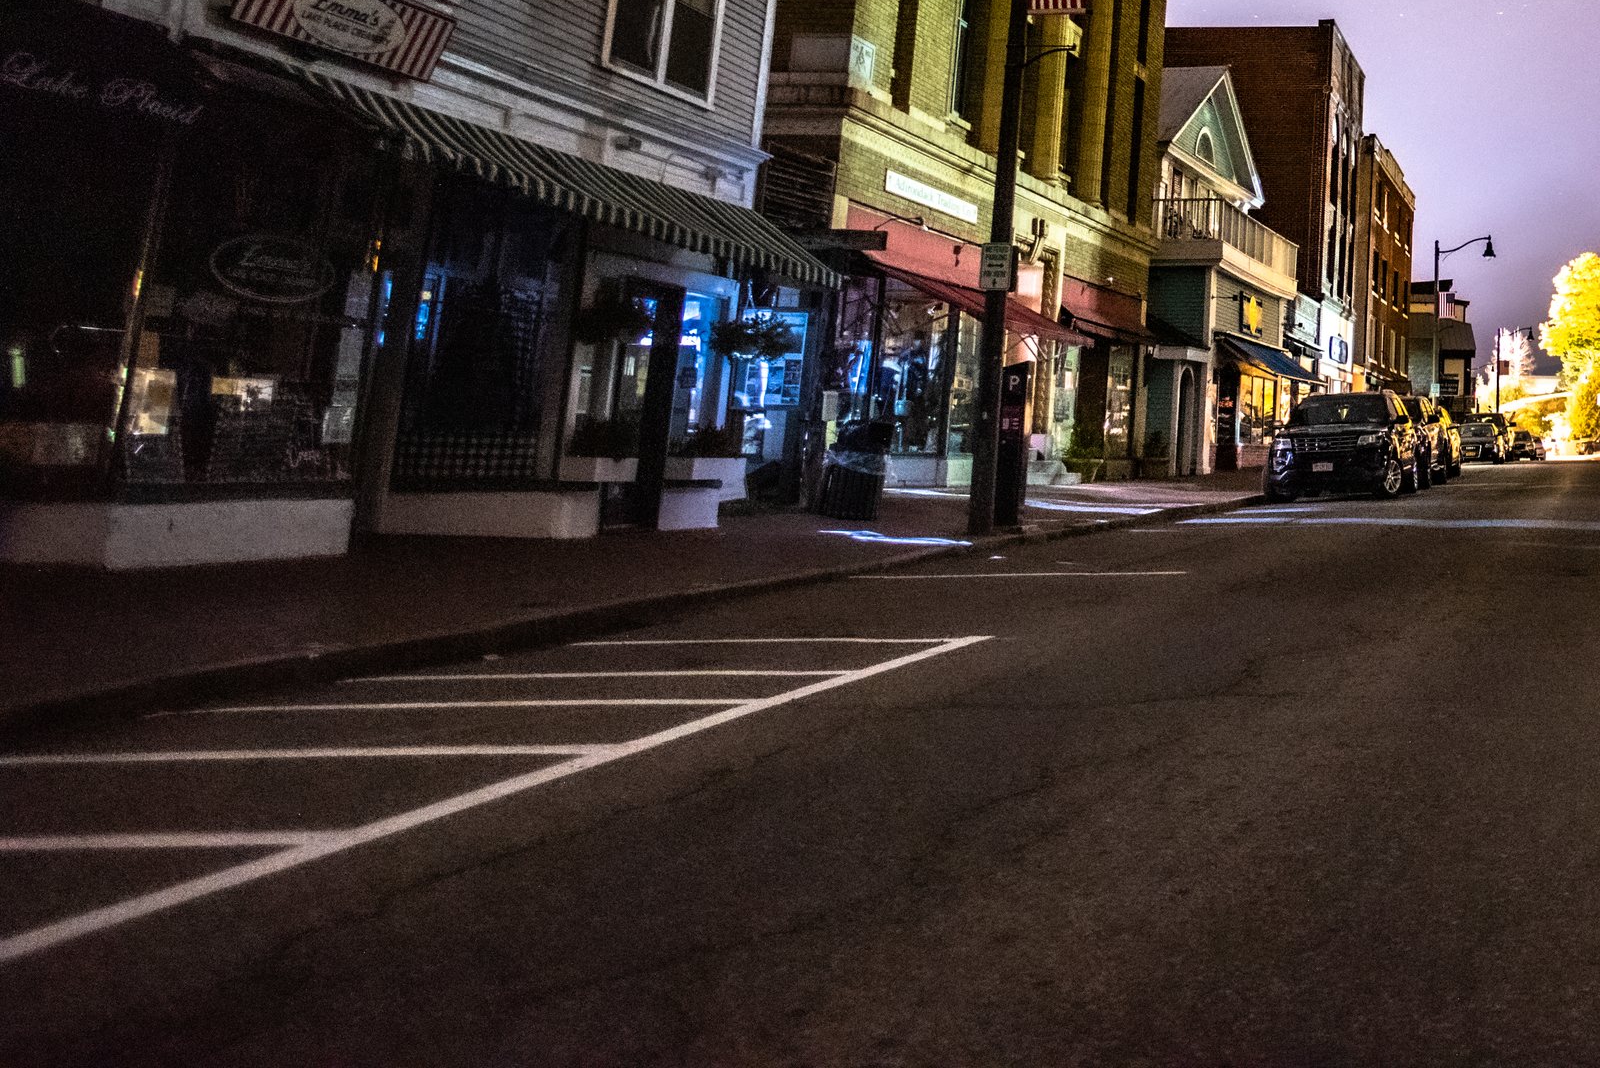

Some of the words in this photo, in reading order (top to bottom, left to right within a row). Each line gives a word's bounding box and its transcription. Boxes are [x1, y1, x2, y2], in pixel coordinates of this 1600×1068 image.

[1, 51, 89, 99] Lake
[100, 77, 204, 125] Placid
[1009, 374, 1020, 391] P
